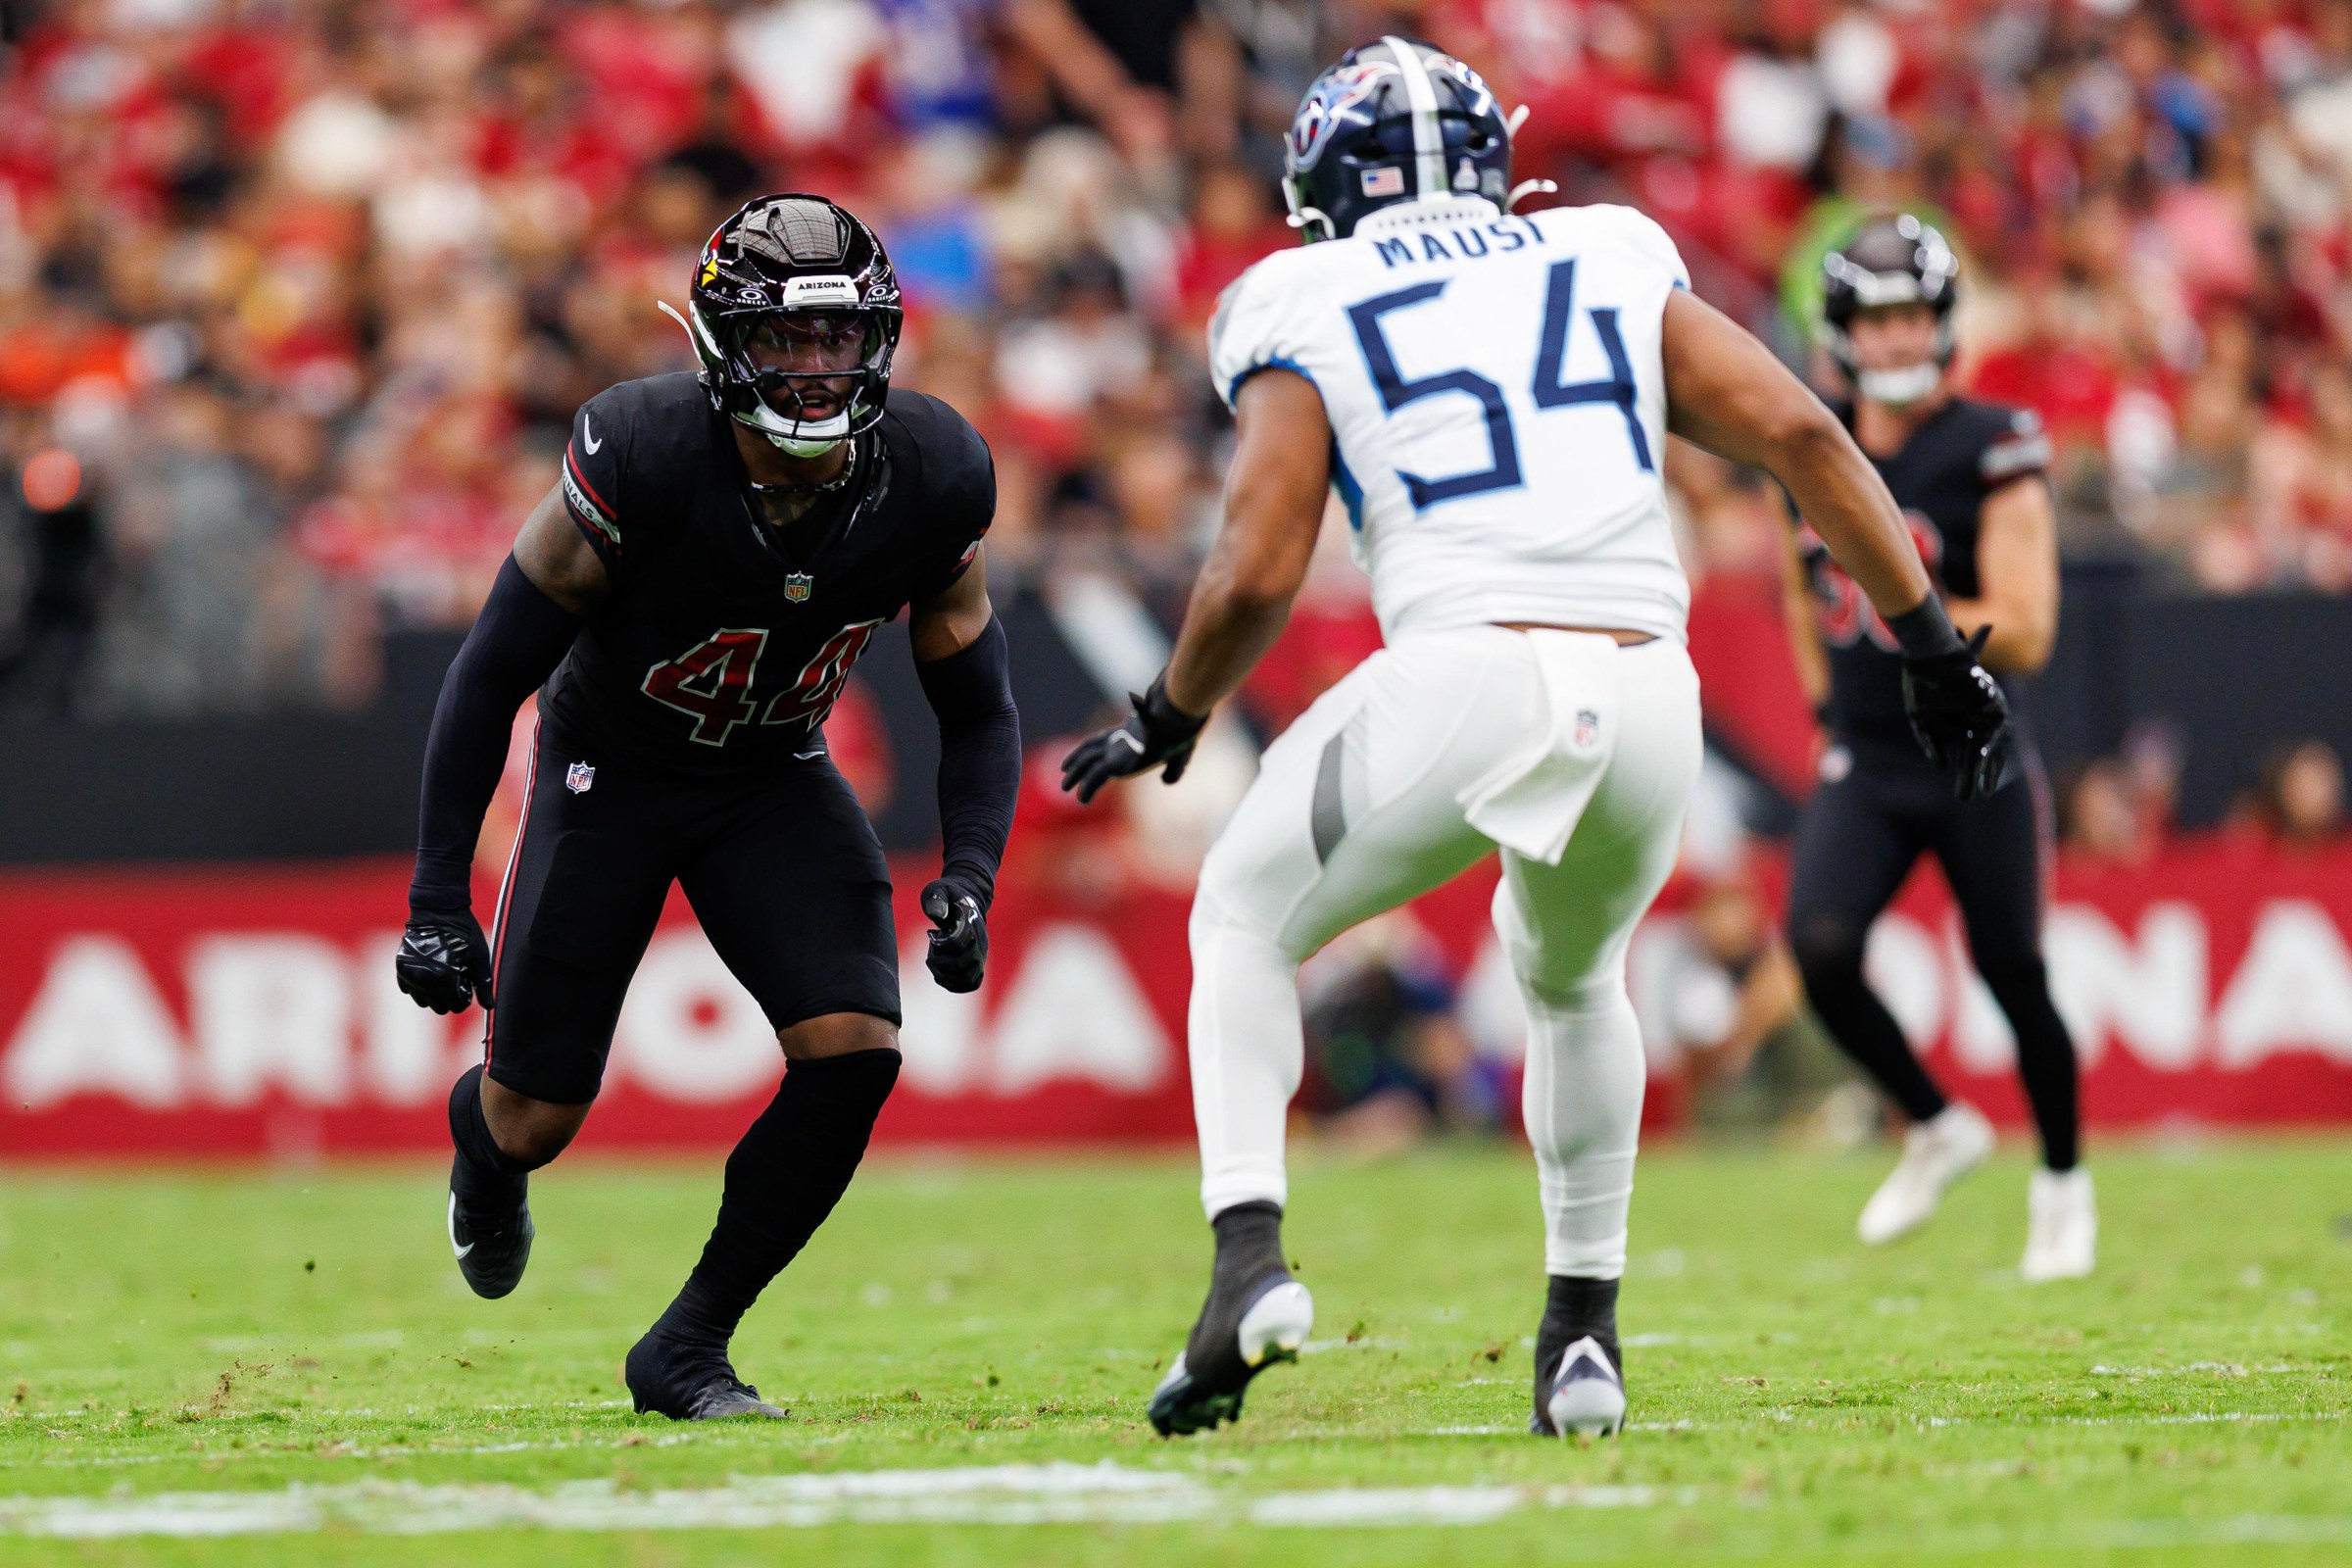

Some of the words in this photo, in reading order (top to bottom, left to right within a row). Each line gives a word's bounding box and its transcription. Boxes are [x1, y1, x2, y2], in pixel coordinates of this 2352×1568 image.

[798, 281, 847, 290] ARIZONA
[1343, 256, 1656, 514] 54
[788, 586, 807, 598] NFL
[640, 617, 886, 747] 44
[570, 774, 589, 787] NFL
[2, 919, 1178, 1112] ARIOA
